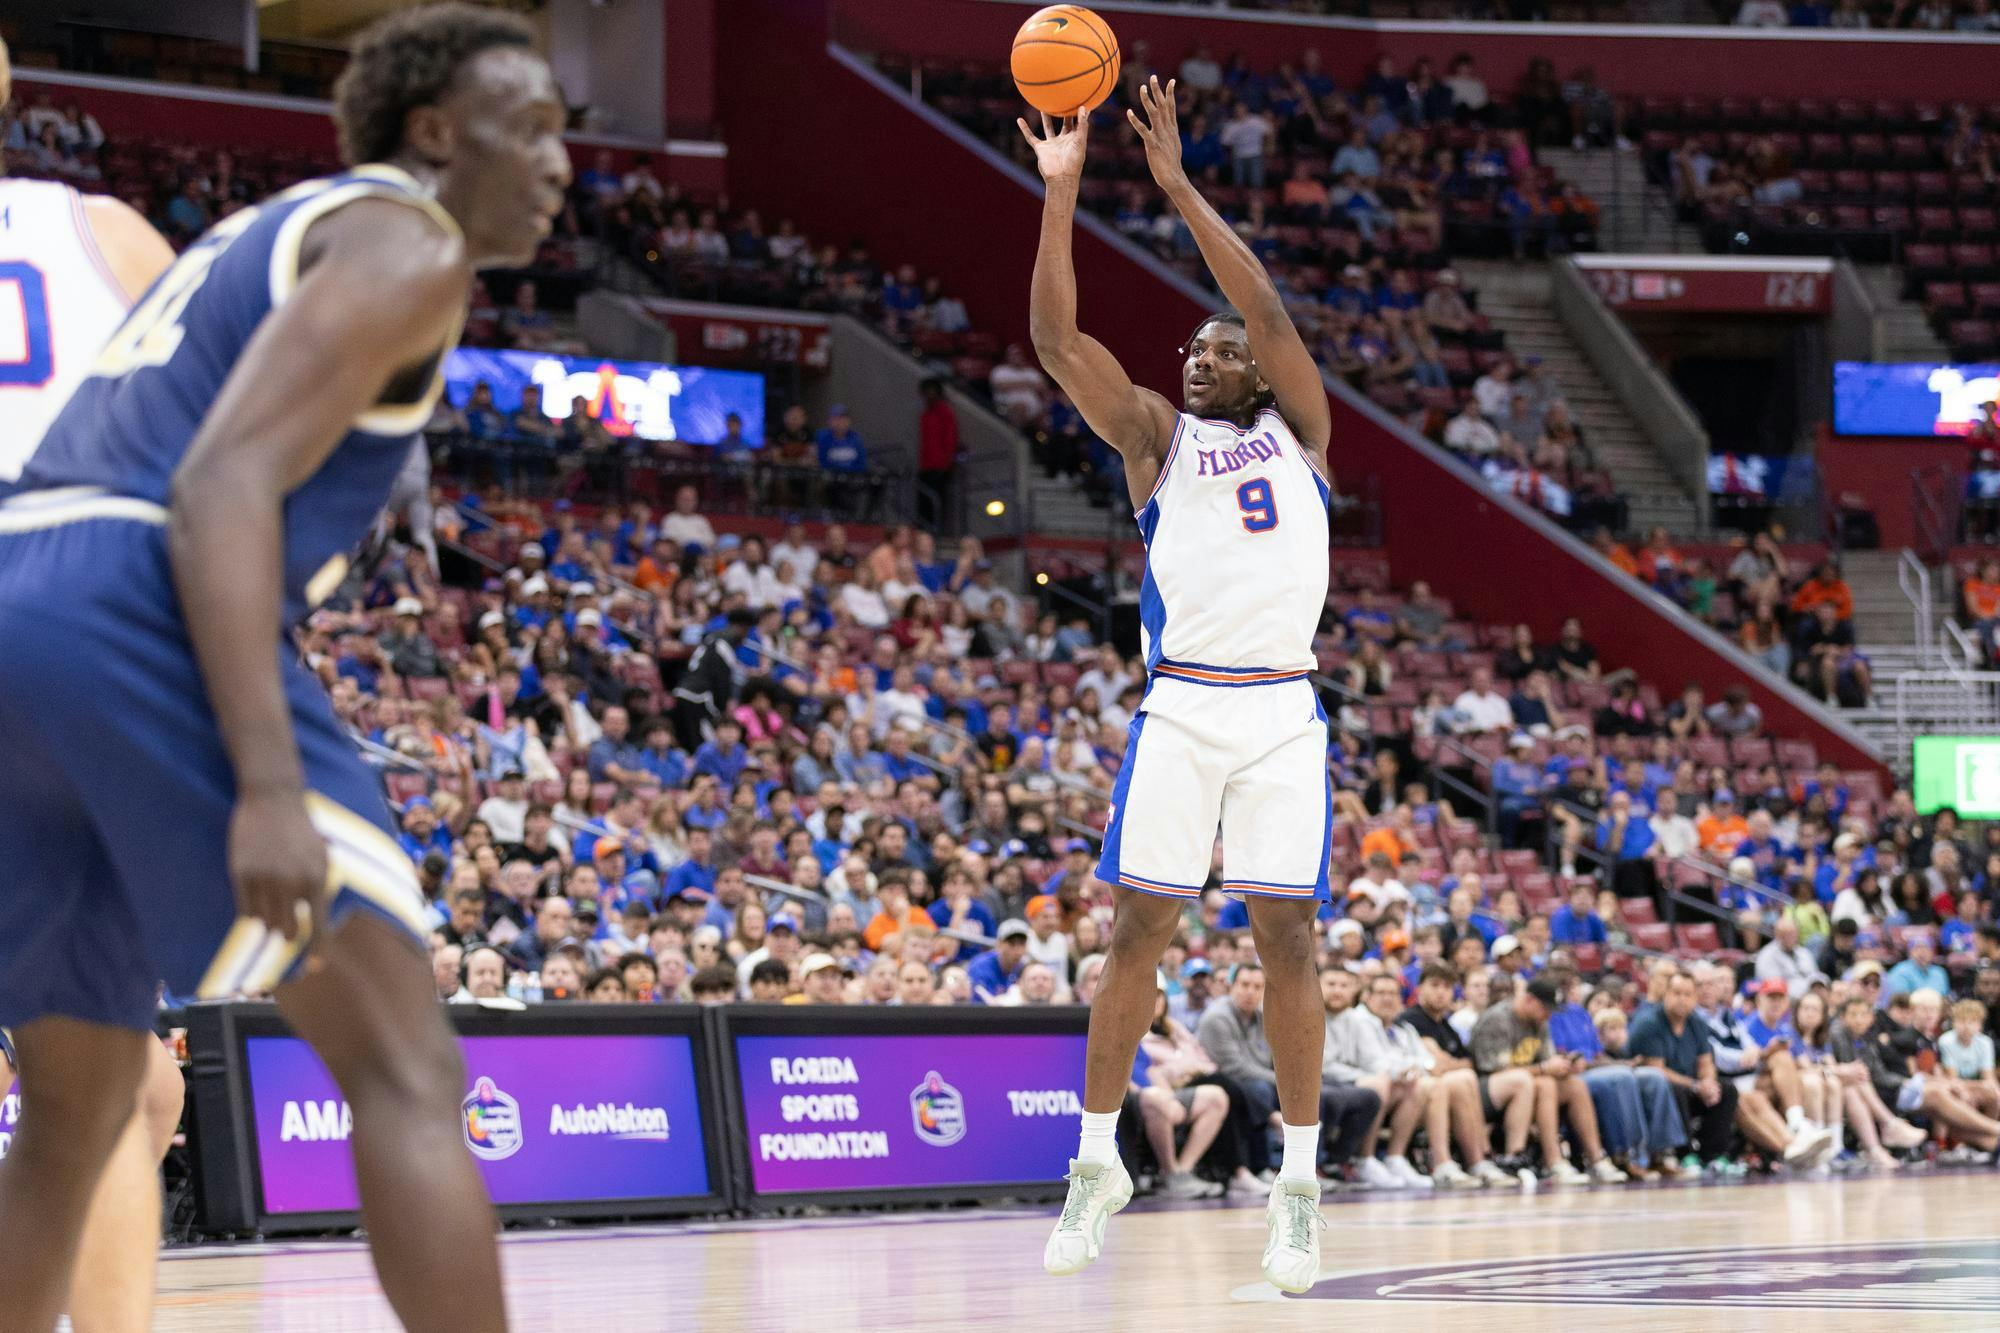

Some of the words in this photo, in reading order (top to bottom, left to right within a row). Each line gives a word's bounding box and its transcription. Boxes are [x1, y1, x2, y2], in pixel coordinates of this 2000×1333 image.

[1197, 431, 1283, 476] FLORD
[1236, 476, 1279, 534] 9
[770, 1057, 859, 1084] FLORIDA
[780, 1094, 859, 1122] SPORTS
[1006, 1090, 1082, 1116] TOYOTA
[549, 1102, 669, 1135] AutoNation
[759, 1131, 889, 1161] FOUNDATION
